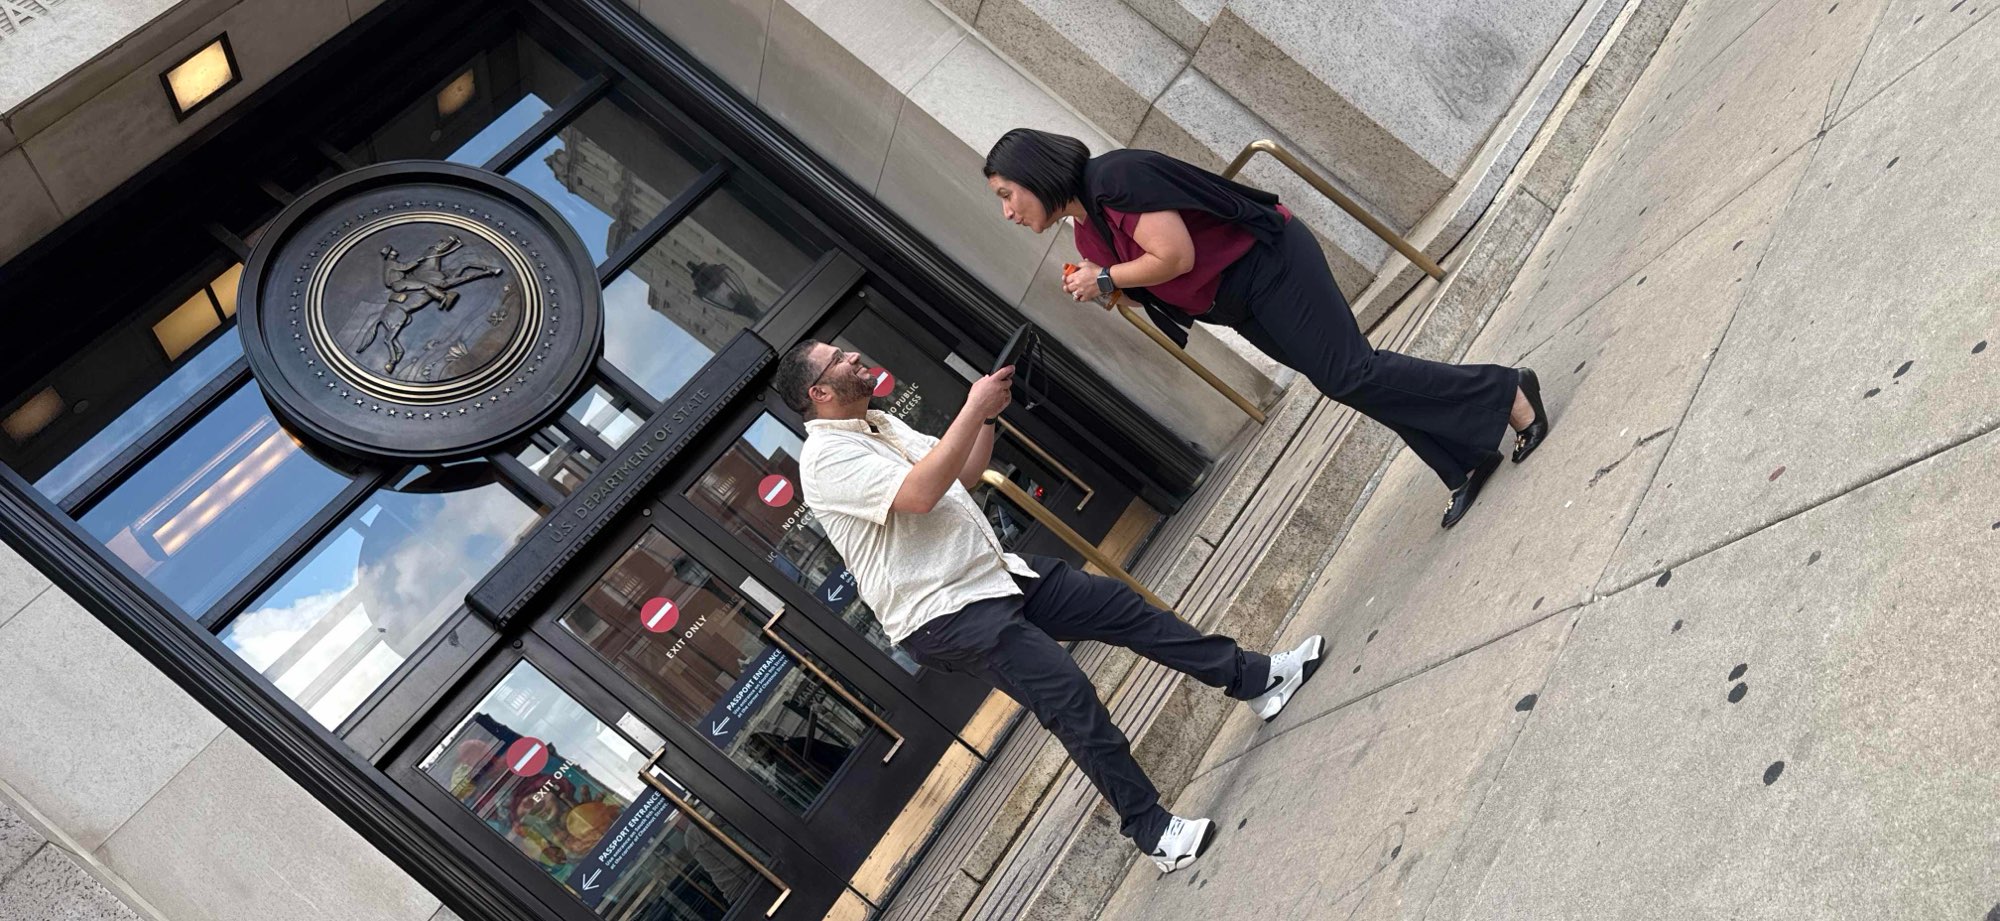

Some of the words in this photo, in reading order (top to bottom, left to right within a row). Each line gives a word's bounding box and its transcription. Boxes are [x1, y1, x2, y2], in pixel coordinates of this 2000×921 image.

[894, 381, 919, 408] PUBLIC
[897, 392, 922, 420] ACCESS
[548, 516, 577, 545] U.S.
[573, 439, 655, 521] DEPARTMENT
[652, 421, 674, 444] OF
[671, 385, 711, 425] STATE
[781, 515, 796, 531] NO
[792, 500, 809, 518] PUB
[795, 509, 815, 531] ACCE
[665, 636, 687, 659] EXIT
[683, 613, 708, 640] ONLY
[725, 678, 755, 711] PASSPORT
[751, 647, 782, 681] ENTRANCE
[731, 705, 741, 715] Use
[738, 688, 756, 707] entrance
[757, 671, 770, 685] South
[773, 653, 786, 667] Street
[757, 686, 764, 694] of
[760, 670, 778, 689] Chestnut
[740, 704, 749, 713] the
[746, 691, 760, 707] corner
[531, 778, 555, 803] EXIT
[551, 753, 578, 781] ONL
[597, 824, 631, 863] PASSPORT
[627, 789, 662, 828] ENTRANCE
[604, 855, 614, 867] Use
[611, 836, 631, 858] entrance
[628, 829, 637, 838] on
[633, 817, 648, 832] South
[644, 809, 654, 819] 9th
[651, 795, 666, 812] Street
[608, 862, 616, 870] at
[613, 854, 623, 865] the
[620, 840, 635, 857] corner
[632, 834, 640, 843] of
[637, 815, 657, 837] Chestnut
[653, 800, 670, 818] Street.
